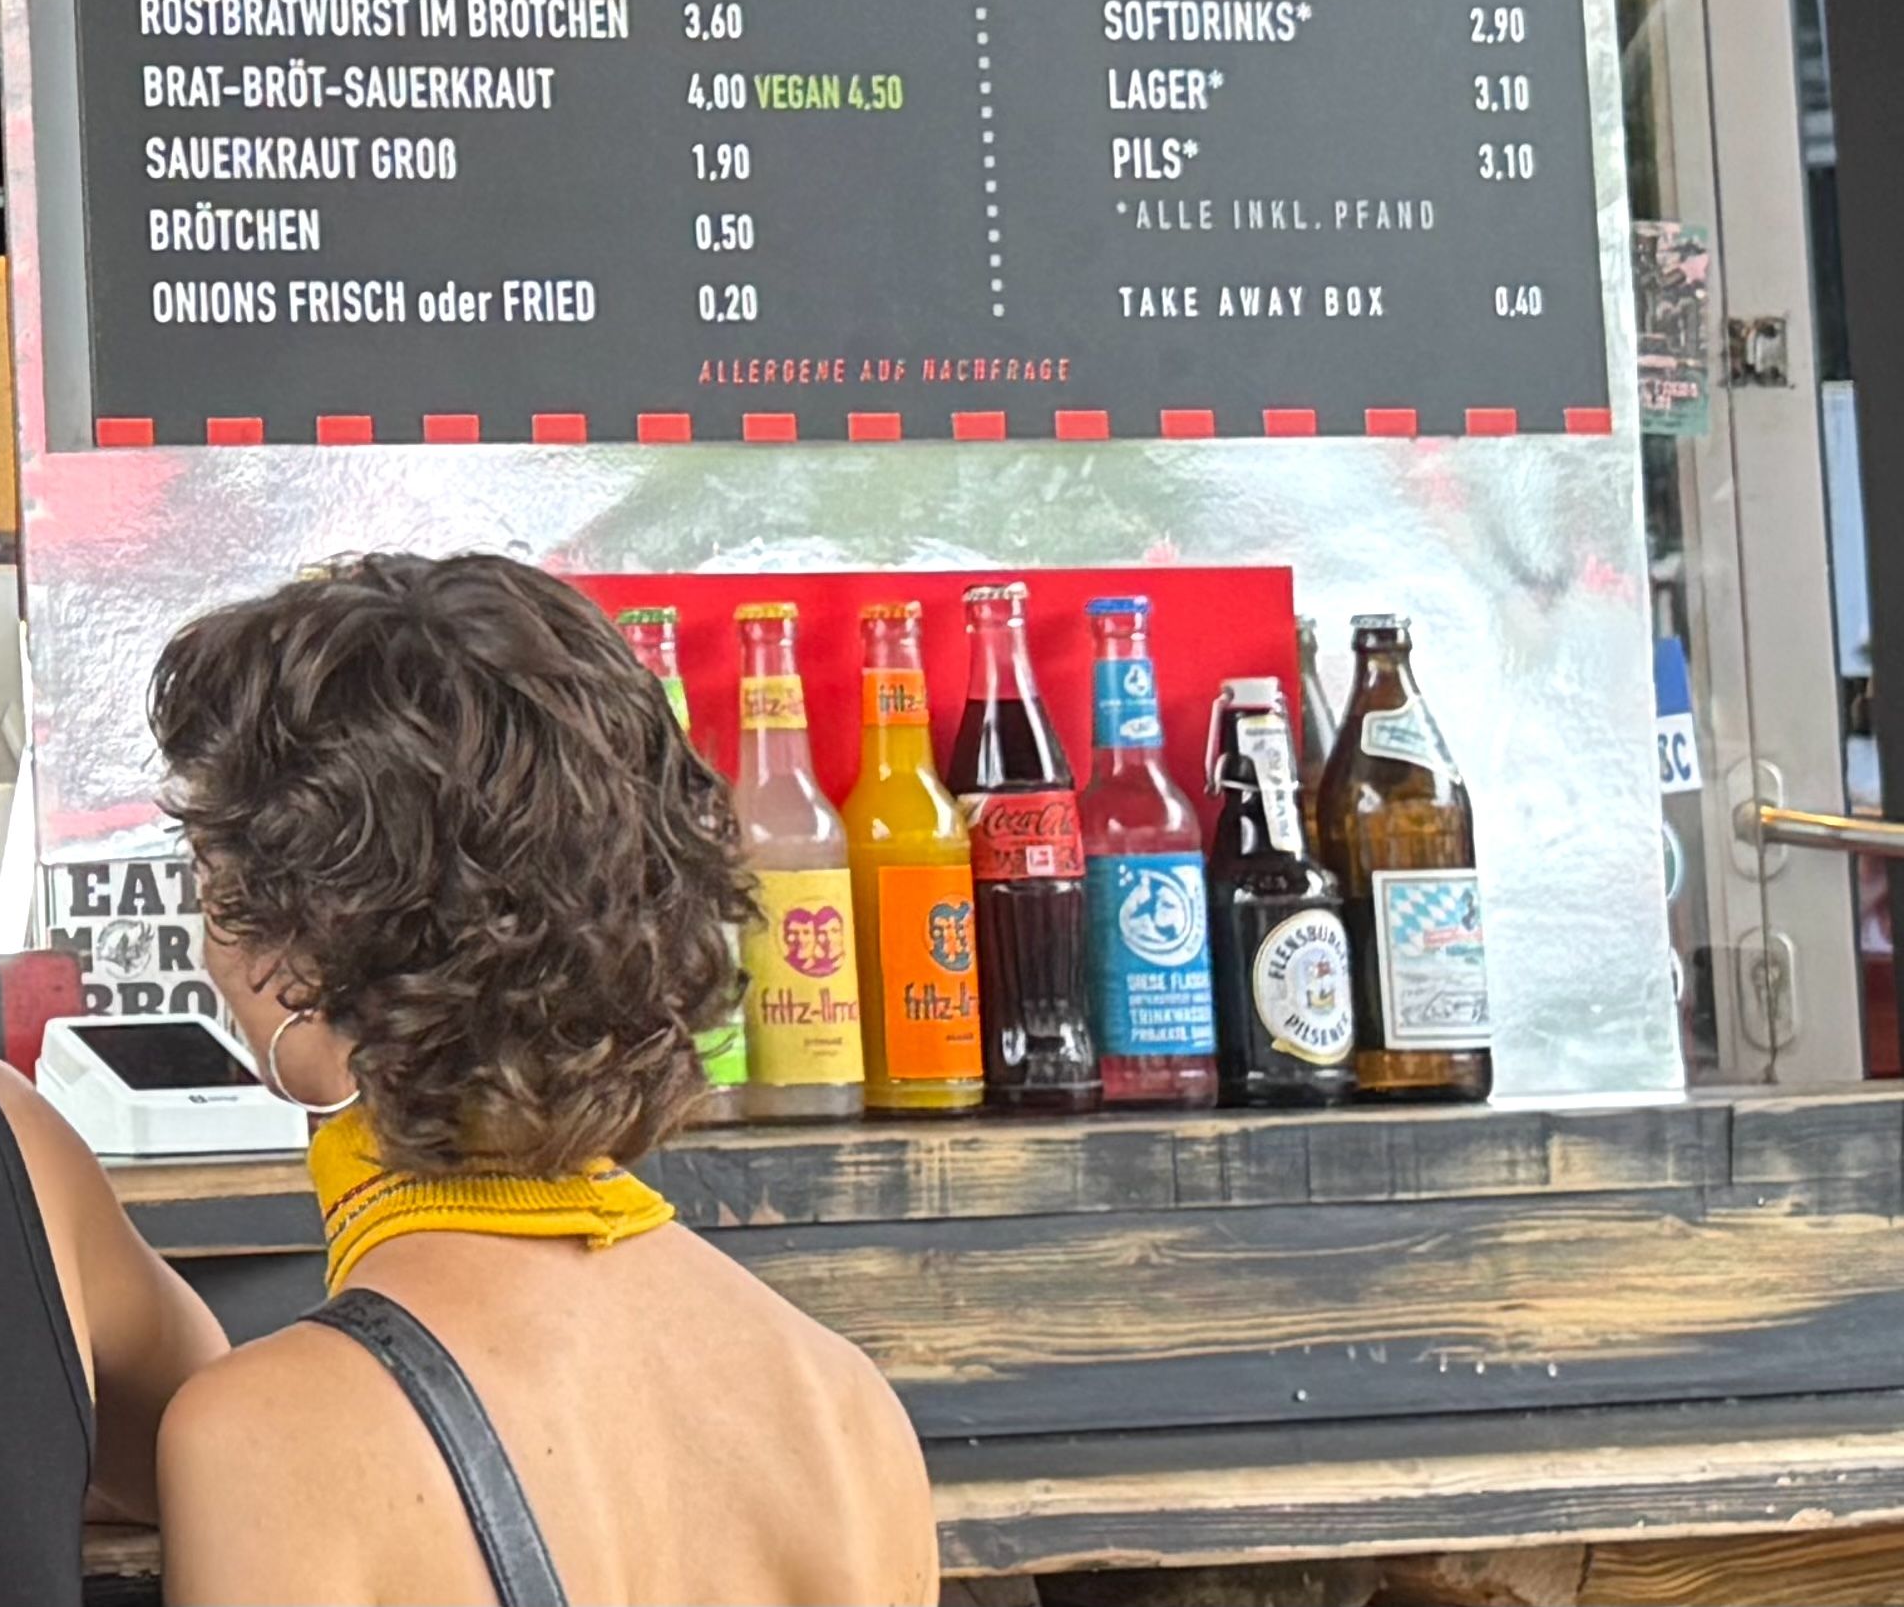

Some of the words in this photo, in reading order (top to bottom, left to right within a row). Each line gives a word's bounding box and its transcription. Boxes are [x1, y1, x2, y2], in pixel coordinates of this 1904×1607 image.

[143, 57, 555, 110] BRAT-BRÖT-SAUERKRAUT
[753, 73, 840, 110] VEGAN
[145, 136, 361, 180] SAUERKRAUT
[149, 200, 321, 252] BRÖTCHEN
[1233, 199, 1322, 230] INKL.
[1334, 199, 1435, 230] PFAND
[152, 280, 277, 324] ONIONS
[288, 279, 406, 323] FRISCH
[418, 280, 493, 323] oder
[502, 279, 596, 322] FRIED
[1118, 286, 1199, 318] TAKE
[1218, 285, 1303, 317] AWAY
[1324, 285, 1384, 317] BOX
